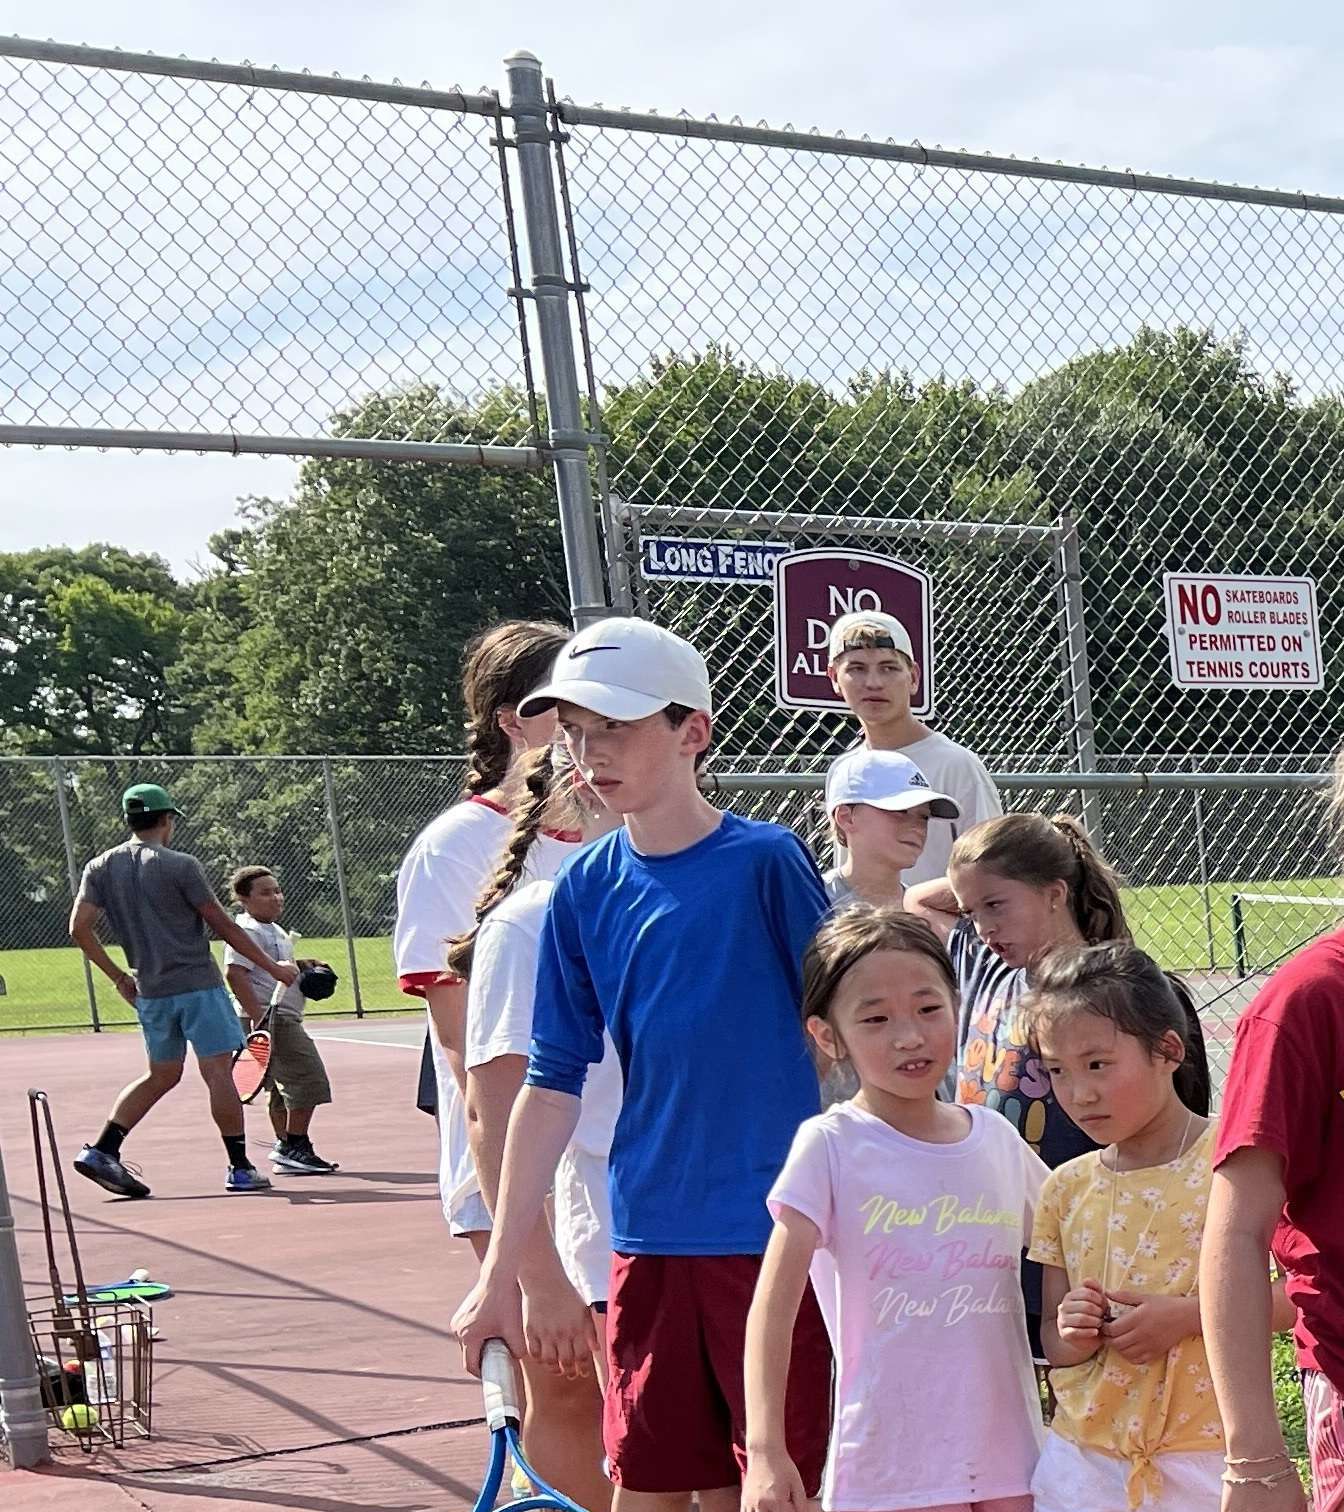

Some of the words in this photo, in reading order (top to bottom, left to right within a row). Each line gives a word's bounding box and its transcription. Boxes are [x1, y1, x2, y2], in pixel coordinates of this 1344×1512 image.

[649, 541, 714, 574] LONG
[717, 546, 784, 577] FENC
[828, 585, 881, 617] NO
[1177, 583, 1222, 626] NO
[1225, 589, 1299, 605] SKATEBOARDS
[1227, 610, 1267, 625] ROLLER
[1269, 611, 1309, 626] BLADES
[1188, 633, 1276, 652] PERMITTED
[1281, 635, 1303, 653] ON
[1185, 660, 1244, 679] TENNIS
[1248, 661, 1310, 679] COURTS
[859, 1194, 928, 1236] New
[864, 1238, 933, 1281] New
[873, 1286, 938, 1326] New
